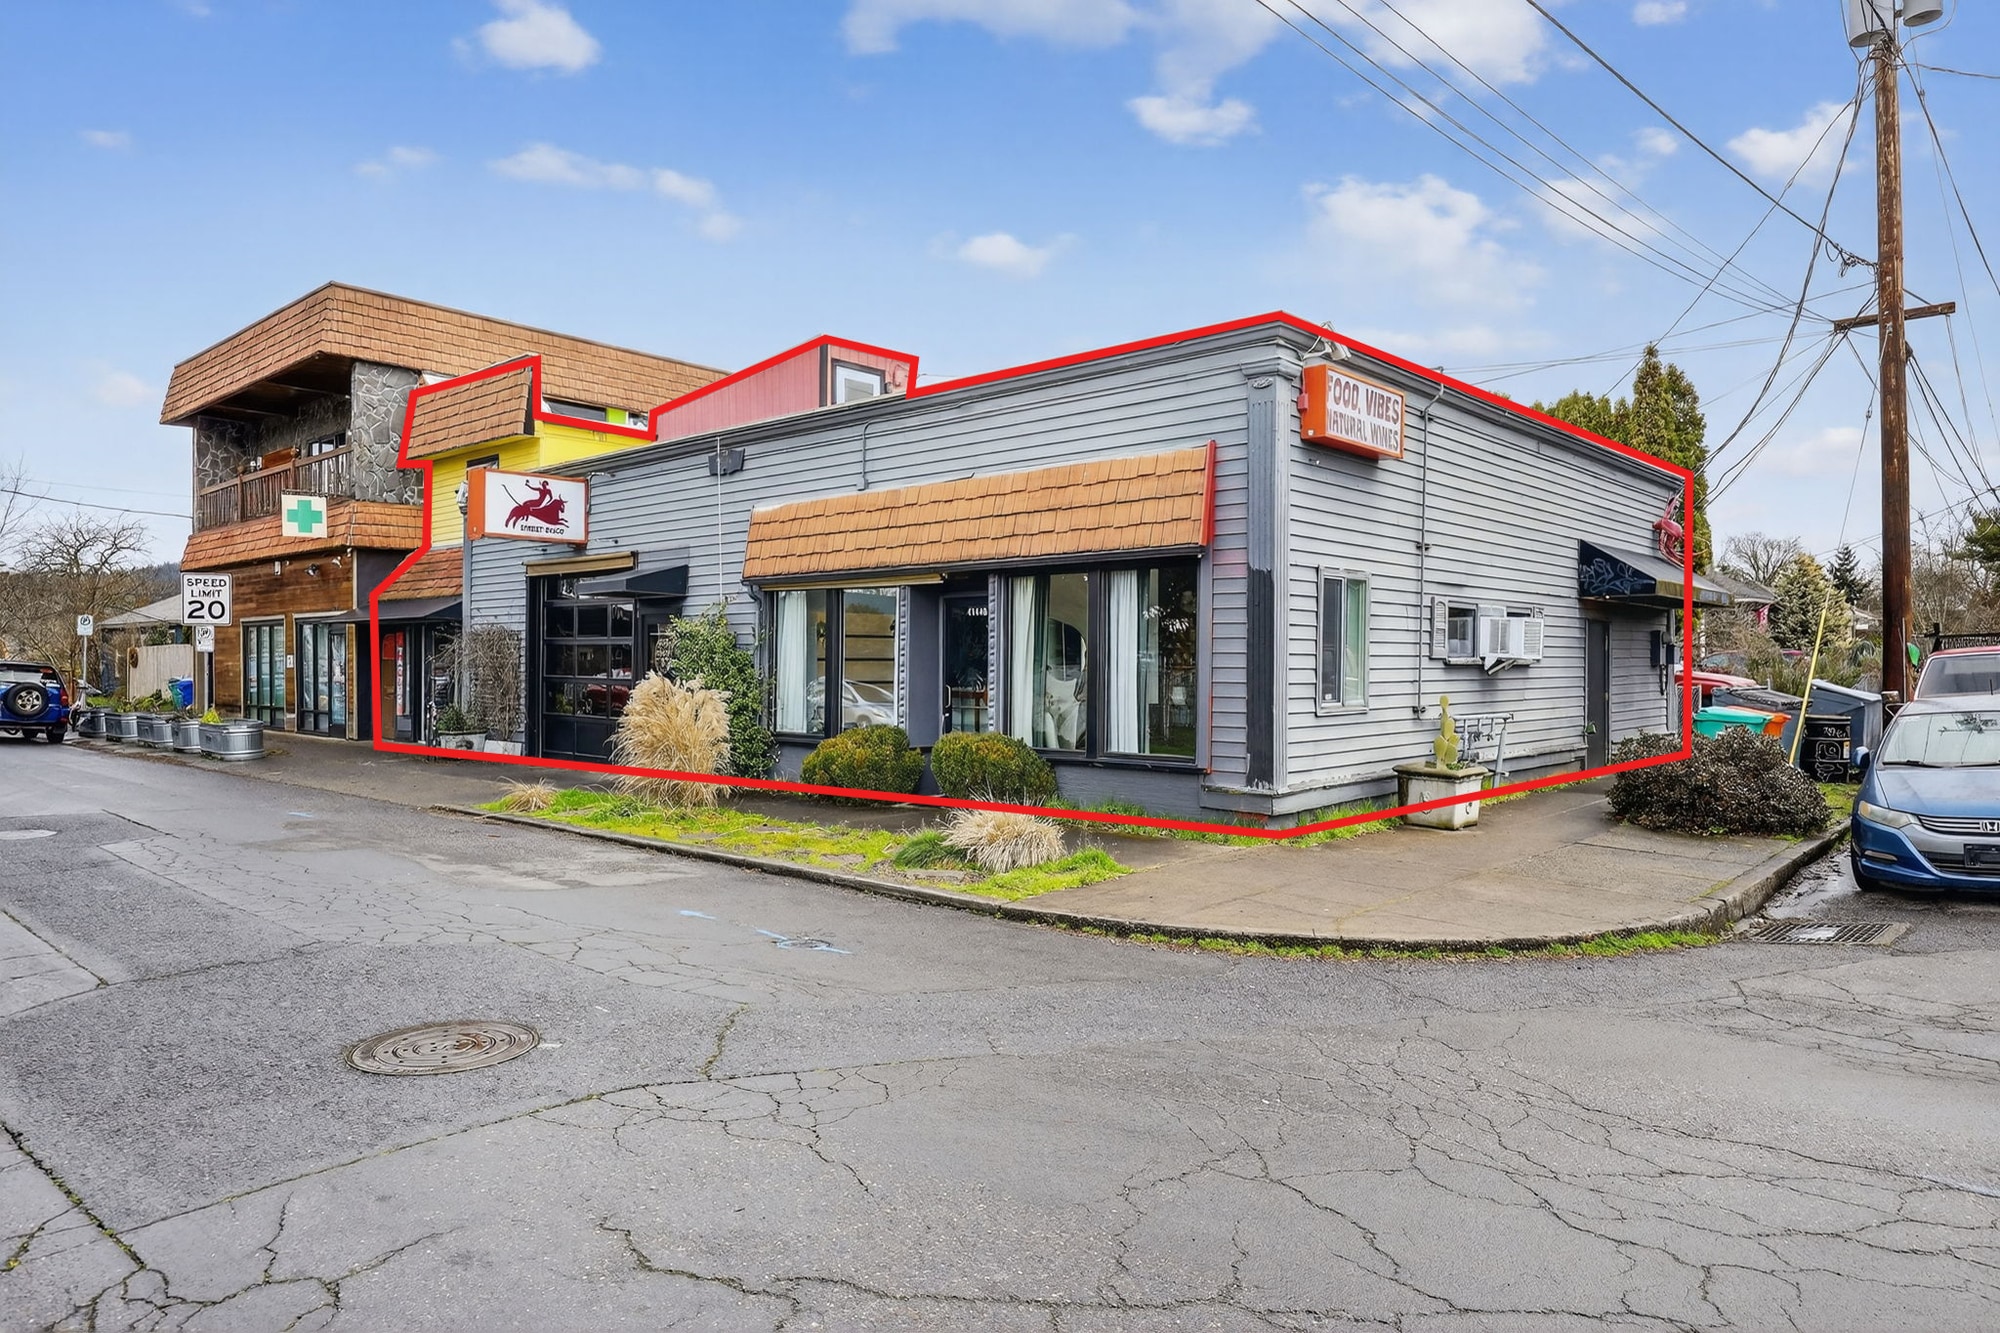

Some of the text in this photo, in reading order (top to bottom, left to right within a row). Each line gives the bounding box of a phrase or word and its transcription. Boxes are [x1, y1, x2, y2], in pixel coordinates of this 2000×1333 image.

[1366, 388, 1399, 425] VIBES
[1327, 408, 1398, 451] NATURAL WINES
[186, 578, 227, 588] SPEED
[190, 589, 222, 598] LIMIT
[187, 600, 226, 620] 20
